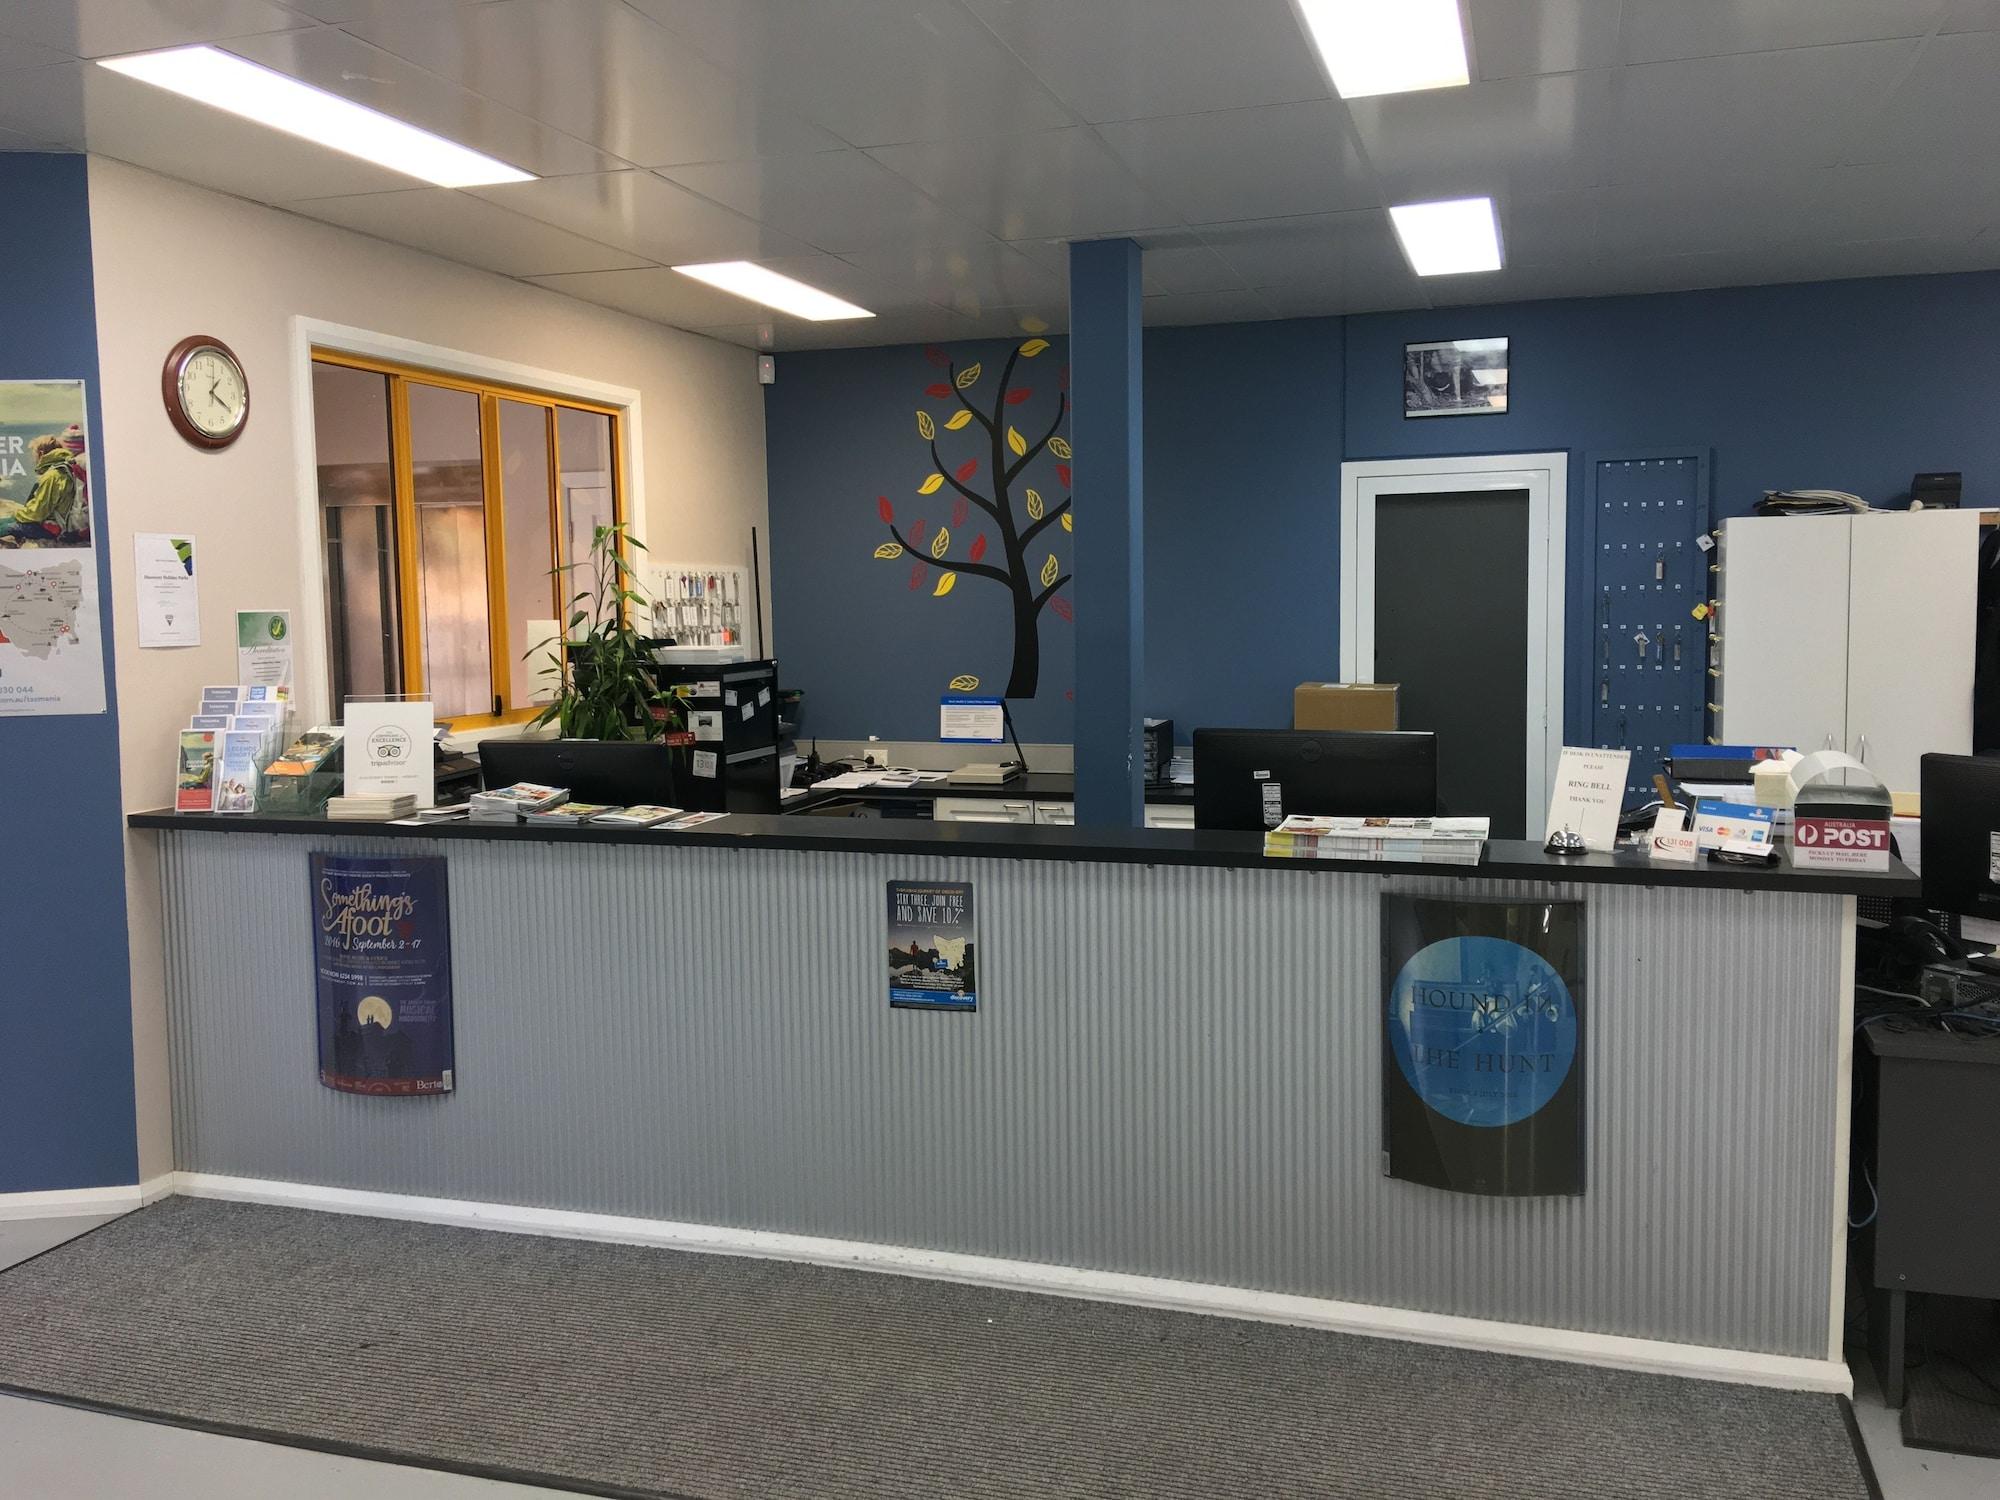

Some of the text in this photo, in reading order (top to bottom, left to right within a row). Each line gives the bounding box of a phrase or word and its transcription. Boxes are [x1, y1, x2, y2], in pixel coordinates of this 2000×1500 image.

[1568, 780, 1612, 790] RING BELL
[1823, 828, 1886, 847] POST
[321, 878, 419, 921] Something's
[896, 893, 909, 905] STAY
[932, 895, 946, 906] JOIN
[949, 895, 963, 907] FREE
[896, 905, 964, 924] AND SAVE 10%
[322, 906, 393, 951] Afoot
[352, 937, 397, 952] September
[1413, 985, 1552, 1014] HOUND IN
[1411, 1045, 1554, 1073] THE HUNT
